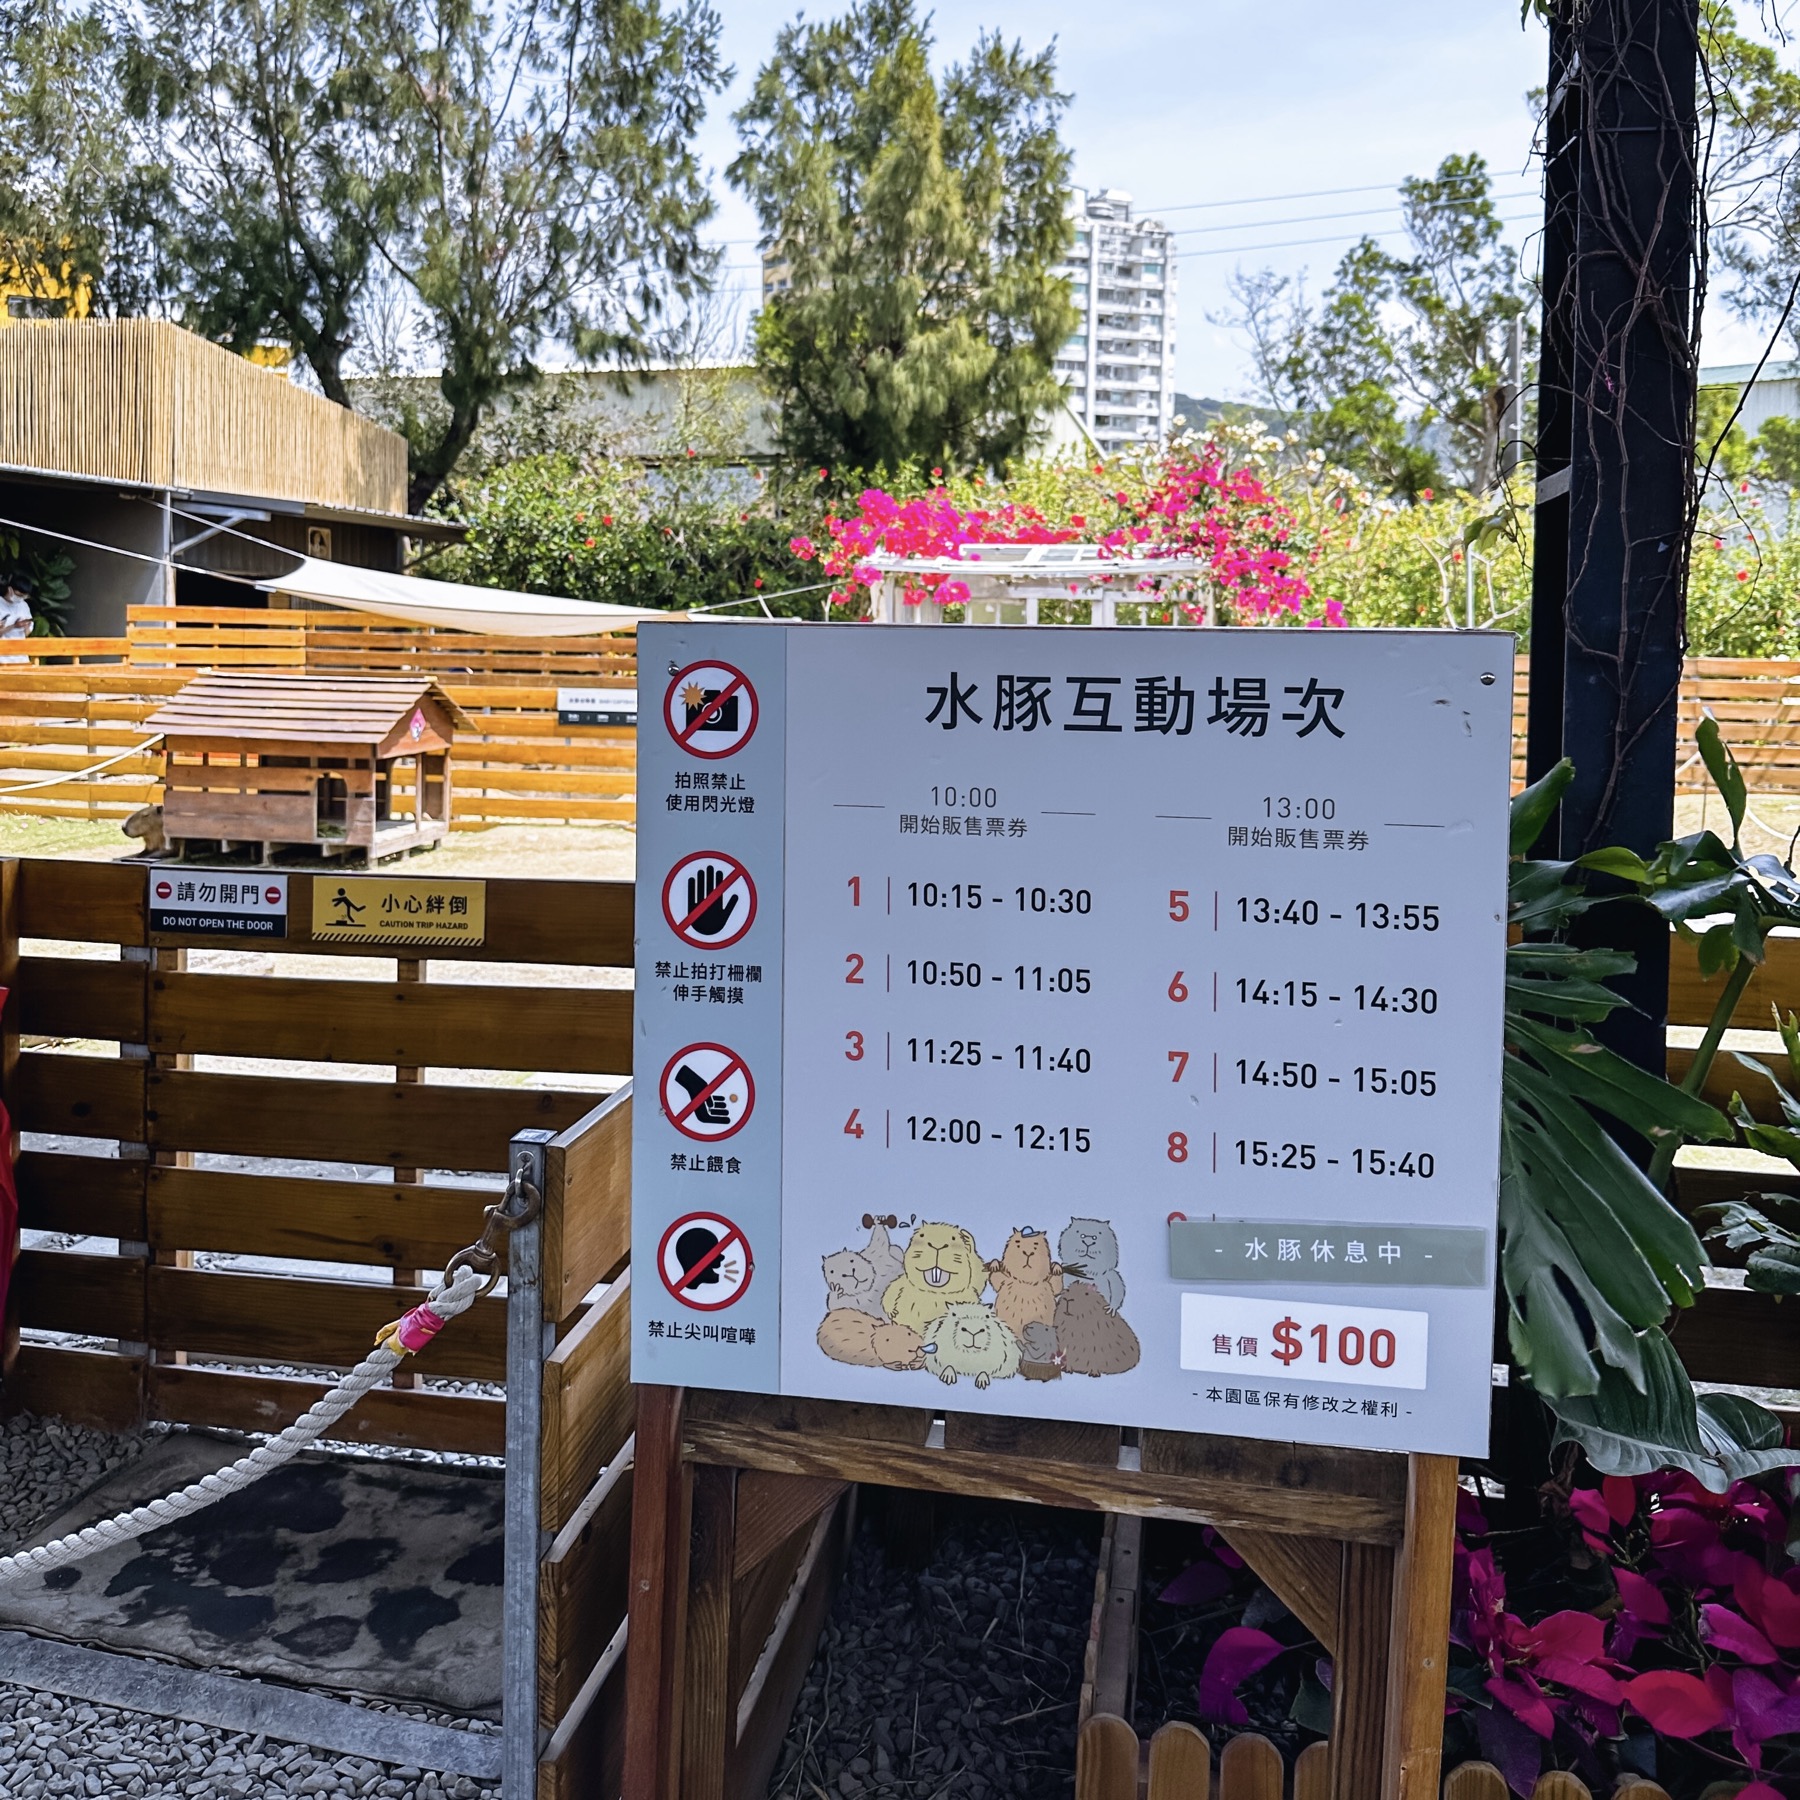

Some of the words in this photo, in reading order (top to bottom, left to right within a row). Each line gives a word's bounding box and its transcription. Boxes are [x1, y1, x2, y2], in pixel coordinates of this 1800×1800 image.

[924, 671, 1346, 739] 水豚互動場次
[674, 771, 746, 791] 拍照禁止
[931, 785, 997, 808] 10:00
[665, 793, 755, 814] 使用閃光燈
[1263, 796, 1335, 820] 13:00
[899, 814, 1028, 838] 開始販售票券
[1228, 826, 1369, 851] 開始販售票券
[177, 881, 260, 905] 請勿開門
[381, 893, 468, 916] 小心絆倒
[847, 875, 861, 907] 1
[907, 882, 982, 910] 10:15
[1015, 886, 1092, 915] 10:30
[1168, 889, 1190, 923] 5
[162, 916, 177, 926] DO
[177, 916, 198, 927] NOT
[198, 917, 225, 928] OPEN
[226, 919, 245, 930] THE
[246, 920, 274, 931] DOOR
[379, 919, 413, 928] CAUTION
[415, 920, 435, 929] TRIP
[435, 921, 469, 930] HAZARD
[1237, 897, 1319, 926] 13:40
[1355, 902, 1440, 932] 13:55
[654, 960, 763, 985] 禁止拍打柵欄
[845, 953, 864, 985] 2
[907, 959, 982, 988] 10:50
[1014, 965, 1091, 994] 11:05
[672, 984, 745, 1006] 伸手觸摸
[1167, 970, 1189, 1003] 6
[1236, 977, 1318, 1008] 14:15
[1354, 984, 1438, 1015] 14:30
[844, 1030, 865, 1062] 3
[907, 1037, 982, 1066] 11:25
[1014, 1044, 1091, 1074] 11:40
[1167, 1050, 1190, 1083] 7
[1236, 1058, 1317, 1089] 14:50
[1353, 1066, 1437, 1097] 15:05
[843, 1108, 865, 1140] 4
[907, 1115, 981, 1145] 12:00
[1014, 1123, 1091, 1153] 12:15
[670, 1152, 742, 1175] 禁止餵食
[1167, 1131, 1189, 1164] 8
[1235, 1139, 1316, 1171] 15:25
[1352, 1148, 1435, 1179] 15:40
[1244, 1236, 1401, 1265] 水豚休息中
[648, 1319, 756, 1346] 禁止尖叫喧嘩
[1211, 1333, 1258, 1358] 售價
[1270, 1315, 1396, 1369] $100
[1205, 1386, 1398, 1418] 本園區保有修改之權利
